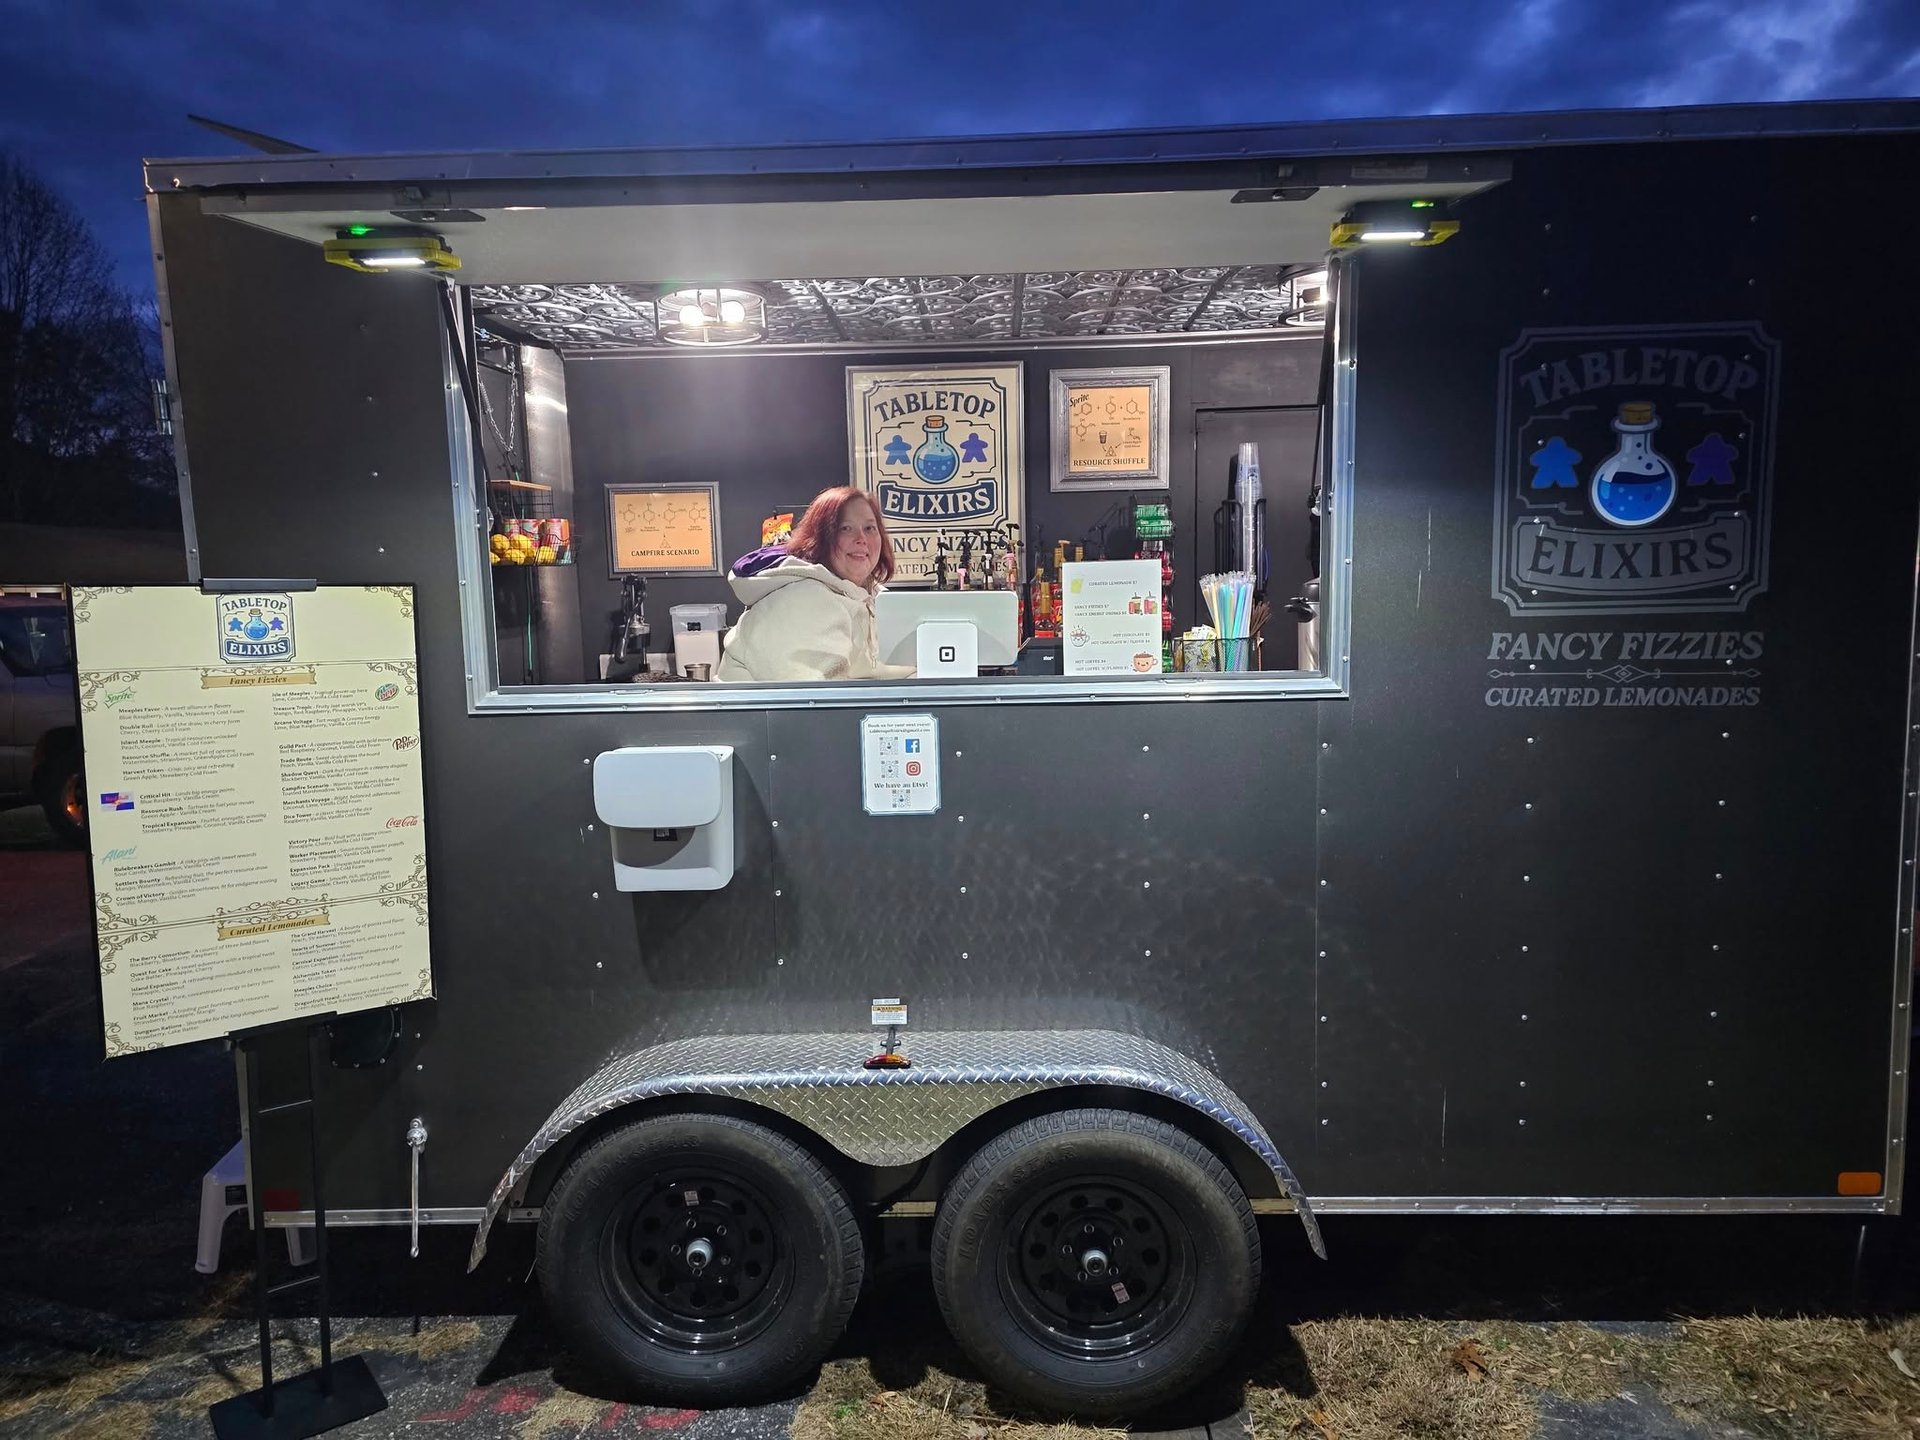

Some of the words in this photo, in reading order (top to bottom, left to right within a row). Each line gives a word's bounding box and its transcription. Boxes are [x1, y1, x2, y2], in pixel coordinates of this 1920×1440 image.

[1520, 347, 1758, 407] TABLETOP
[875, 391, 996, 422] TABLETOP
[1074, 458, 1111, 466] RESOURCE
[885, 488, 990, 515] ELIXIRS
[893, 537, 930, 552] NCY
[1529, 532, 1733, 579] ELIXIRS
[897, 563, 928, 574] ATED
[222, 597, 287, 612] TABLETOP
[229, 641, 287, 656] ELIXIRS
[1487, 633, 1616, 661] FANCY
[1620, 632, 1765, 659] FIZZIES
[229, 676, 255, 686] Fancy
[257, 675, 287, 685] Fizzies
[106, 690, 134, 704] Sprite
[1485, 687, 1602, 707] CURATED
[1605, 687, 1761, 706] LEMONADES
[396, 738, 417, 750] Pepper
[230, 923, 265, 937] Curated
[268, 917, 316, 931] Lemonades
